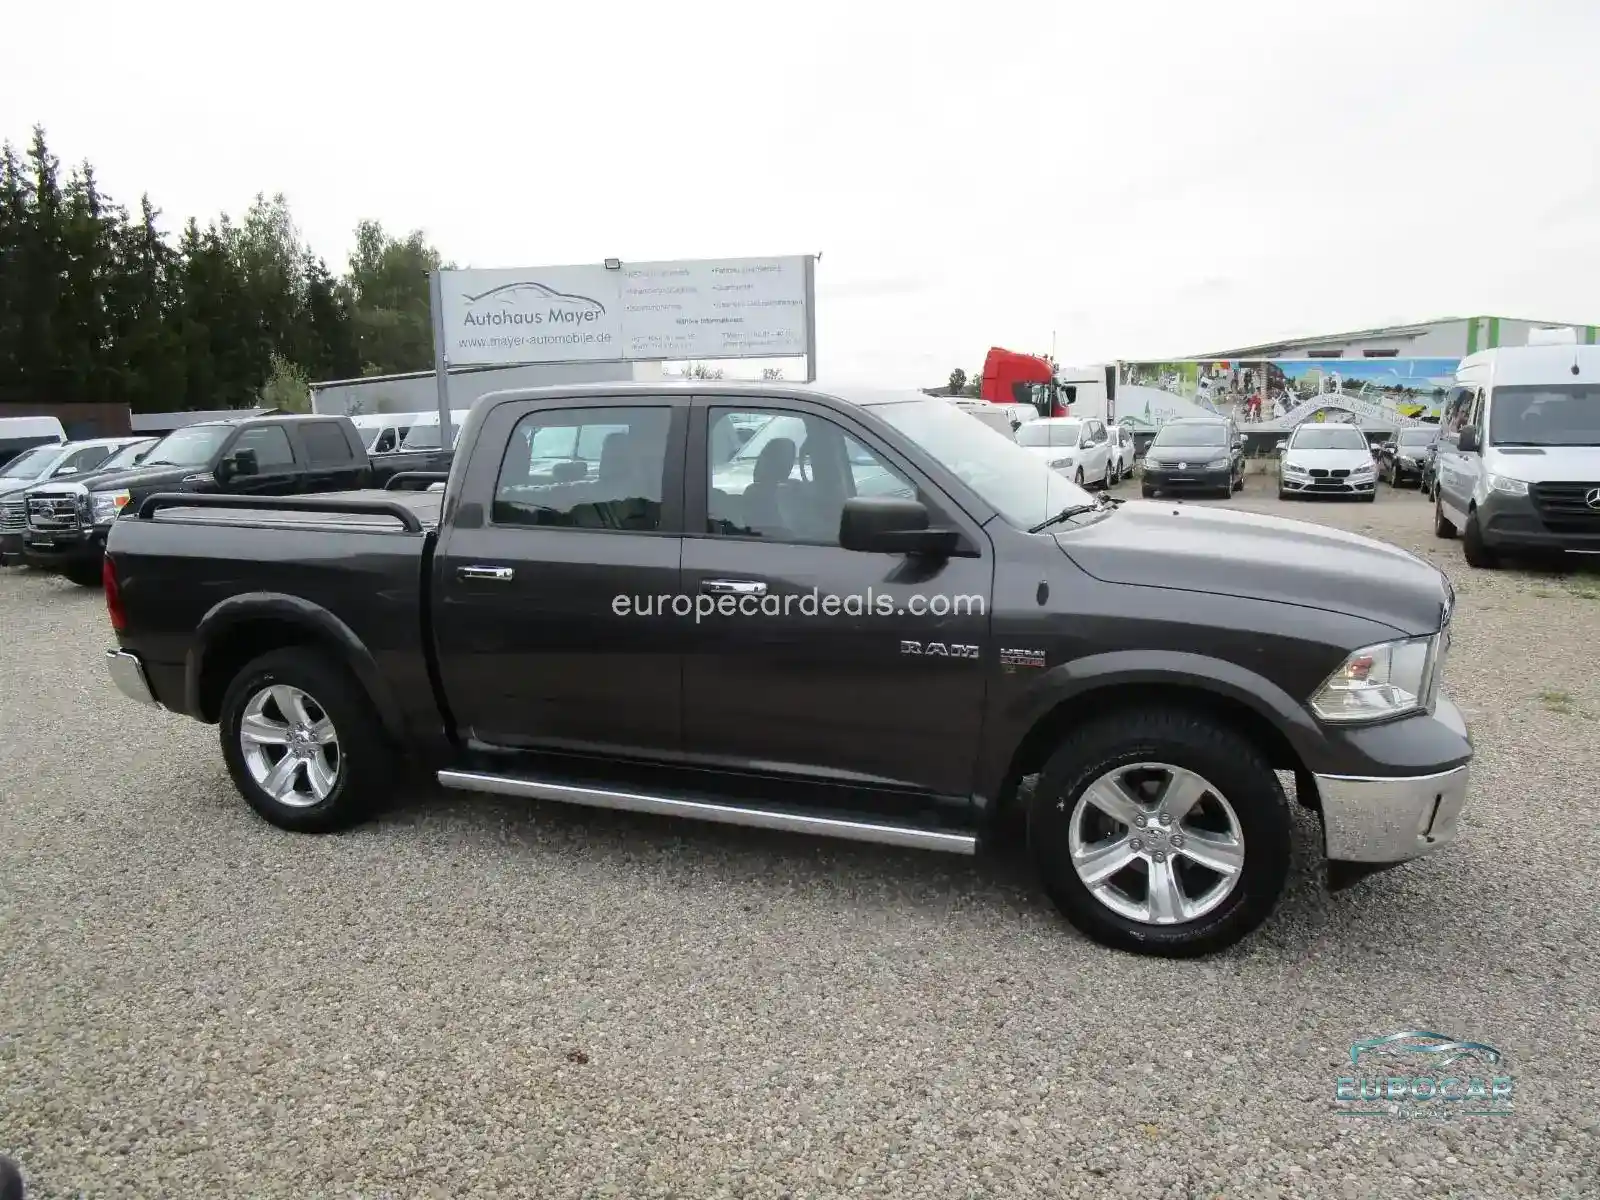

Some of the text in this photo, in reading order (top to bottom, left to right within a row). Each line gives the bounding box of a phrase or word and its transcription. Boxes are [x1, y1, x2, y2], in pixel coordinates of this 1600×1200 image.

[463, 308, 601, 327] Autohaus Mayer
[458, 332, 612, 349] www.mayer-automobile.de
[900, 640, 980, 658] RAM
